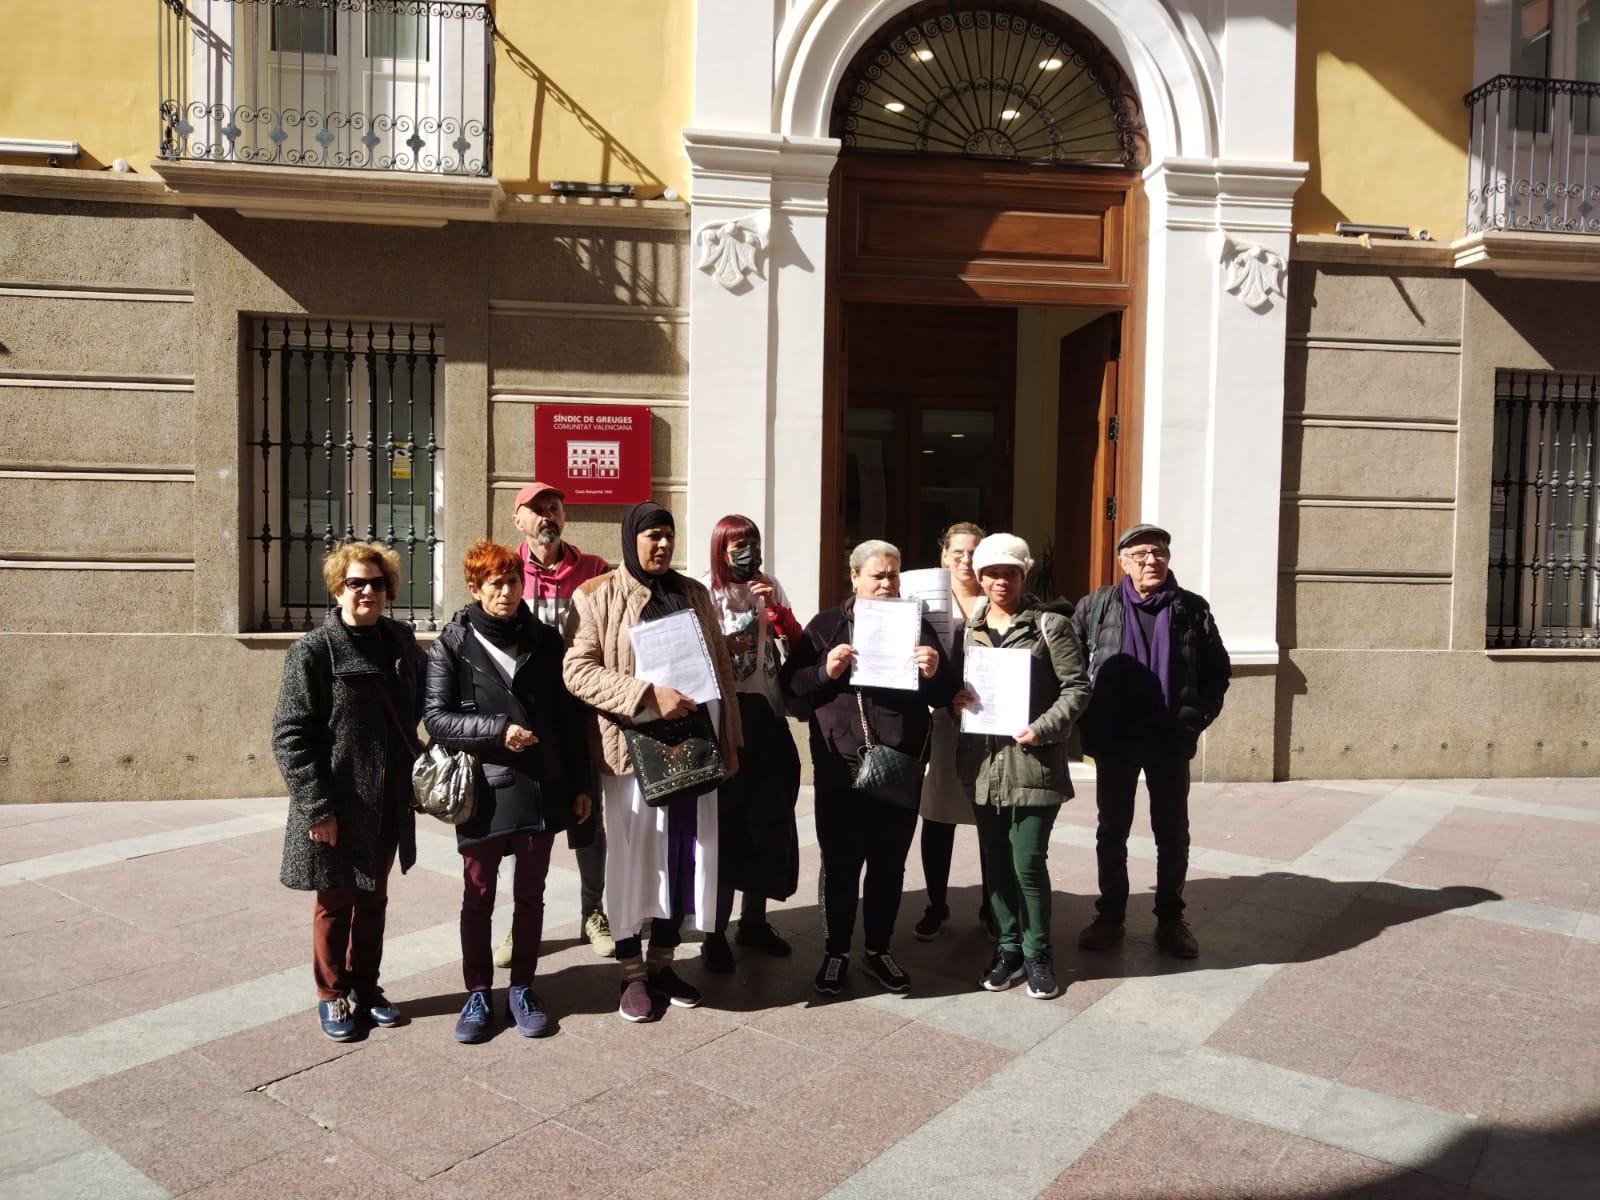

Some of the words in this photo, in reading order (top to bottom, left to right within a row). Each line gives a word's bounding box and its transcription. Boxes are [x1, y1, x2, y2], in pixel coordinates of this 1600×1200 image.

[553, 414, 581, 423] SÍNDIC
[584, 415, 594, 423] DE
[596, 416, 632, 424] GREUGES
